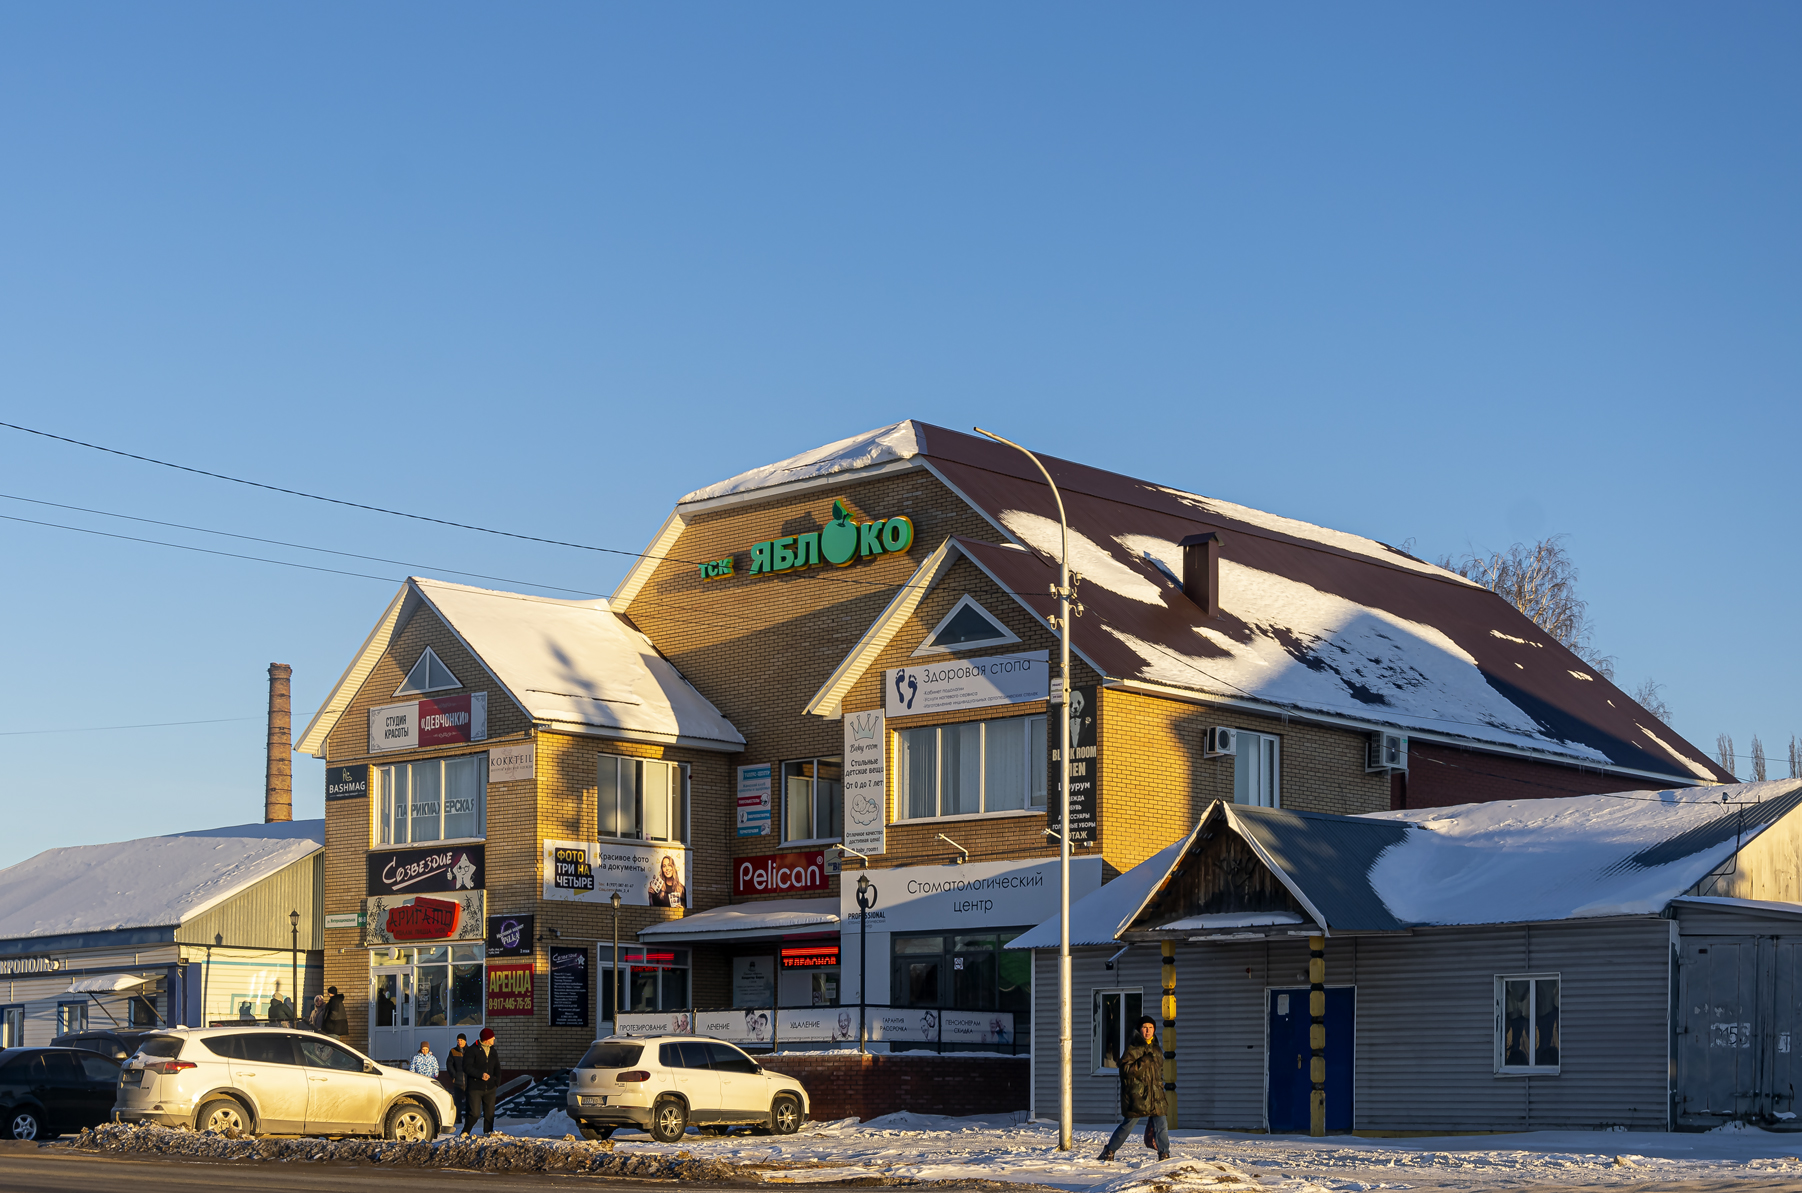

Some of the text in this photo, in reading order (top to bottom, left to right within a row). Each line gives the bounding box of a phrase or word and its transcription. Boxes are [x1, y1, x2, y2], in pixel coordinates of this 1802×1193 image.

[698, 558, 733, 580] ТСК
[923, 660, 1031, 683] Здоровая стопа
[386, 714, 407, 728] СТУДИЯ
[421, 711, 469, 731] «ДЕВЧОНКИ»
[384, 727, 409, 740] КРАСОТЫ
[1076, 745, 1097, 759] ROOM
[491, 754, 533, 767] KOKKTEIL
[851, 758, 879, 767] Стильные
[845, 768, 868, 777] детские
[329, 781, 366, 793] BASHMAG
[846, 782, 854, 790] От
[556, 849, 585, 863] ФОТО
[598, 852, 650, 864] Красивое фото
[556, 863, 590, 876] ТРИ НА
[608, 862, 646, 873] документы
[556, 875, 593, 889] ЧЕТЫРЕ
[739, 860, 820, 891] Pelican
[907, 871, 1043, 895] Стоматологический
[953, 898, 994, 914] центр
[489, 970, 532, 995] АРЕНДА
[619, 1023, 668, 1032] ПРОТЕЗИРОВАНИЕ
[706, 1022, 730, 1031] ЛЕЧЕНИЕ
[789, 1020, 820, 1029] УДАЛЕНИЕ
[946, 1019, 981, 1027] ПЕНСИОНЕРАМ
[953, 1027, 974, 1035] СКИДКА
